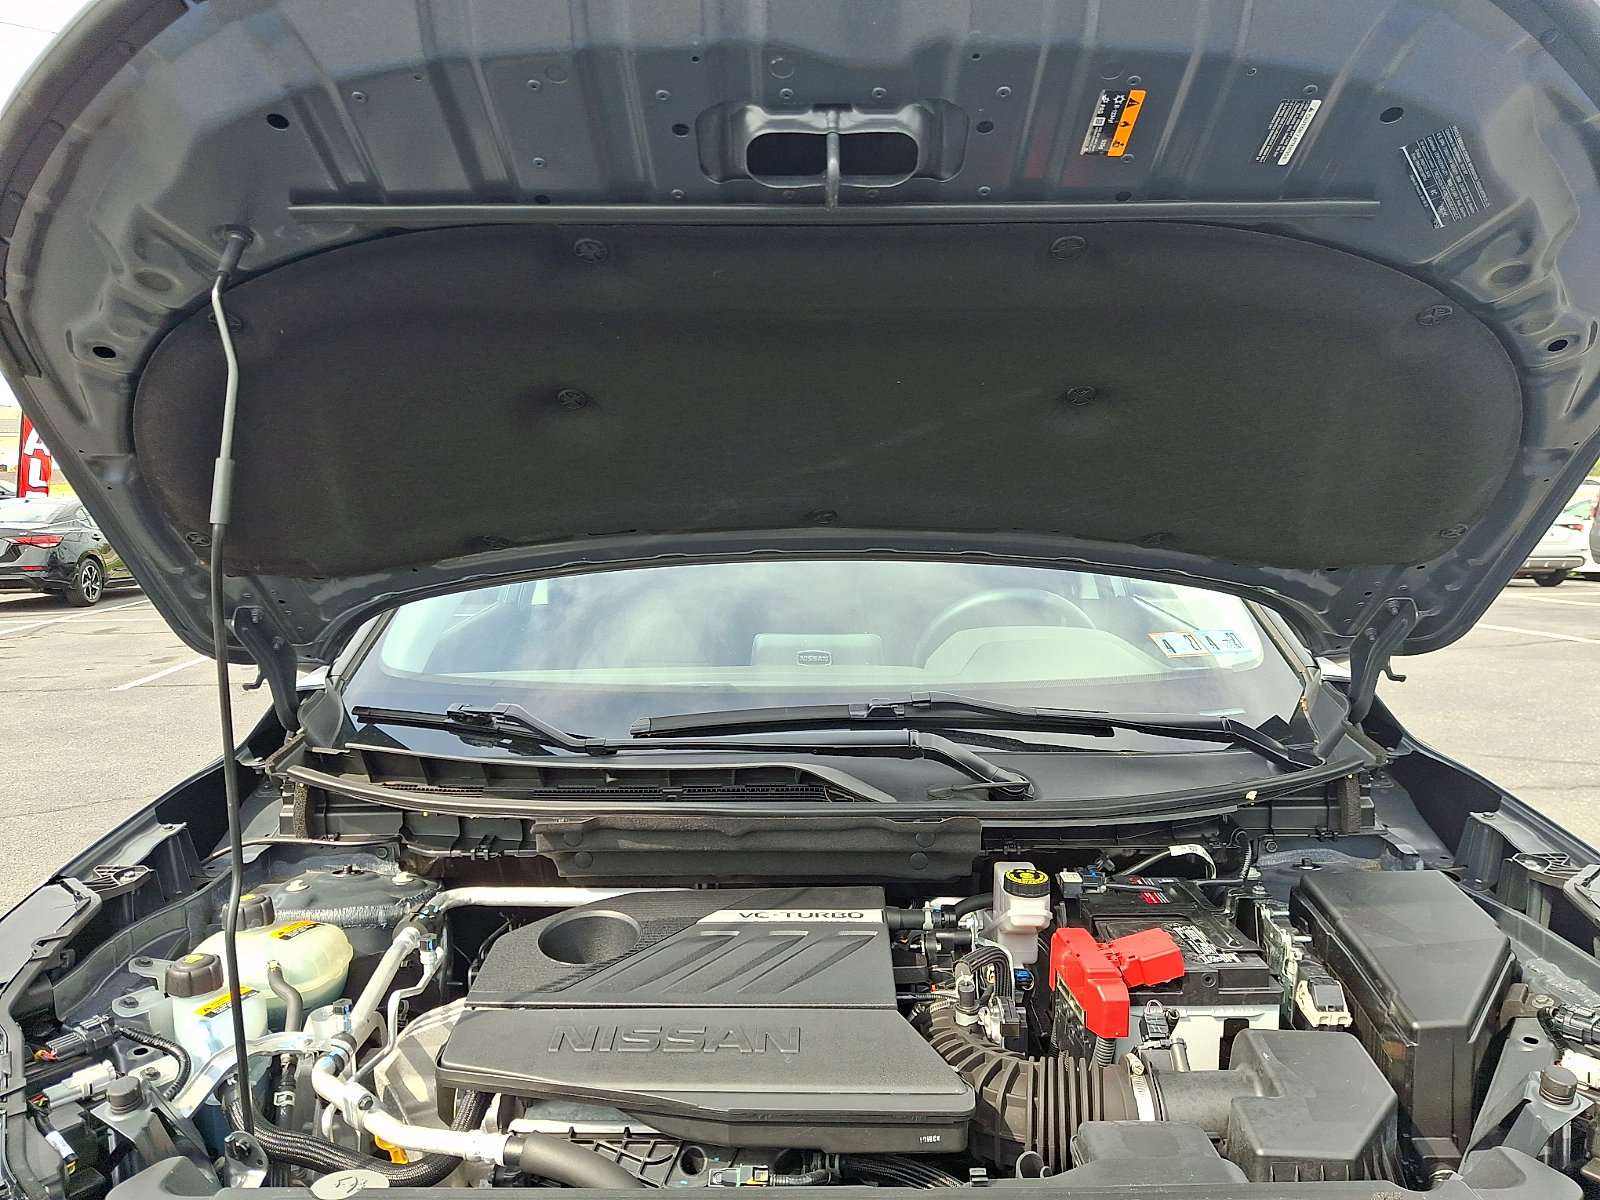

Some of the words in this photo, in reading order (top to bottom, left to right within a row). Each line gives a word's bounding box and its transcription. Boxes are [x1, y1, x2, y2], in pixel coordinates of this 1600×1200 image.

[1162, 639, 1176, 653] 4
[1205, 635, 1220, 650] 4
[738, 911, 865, 919] VC-TURBO
[548, 1025, 801, 1054] NISSAN
